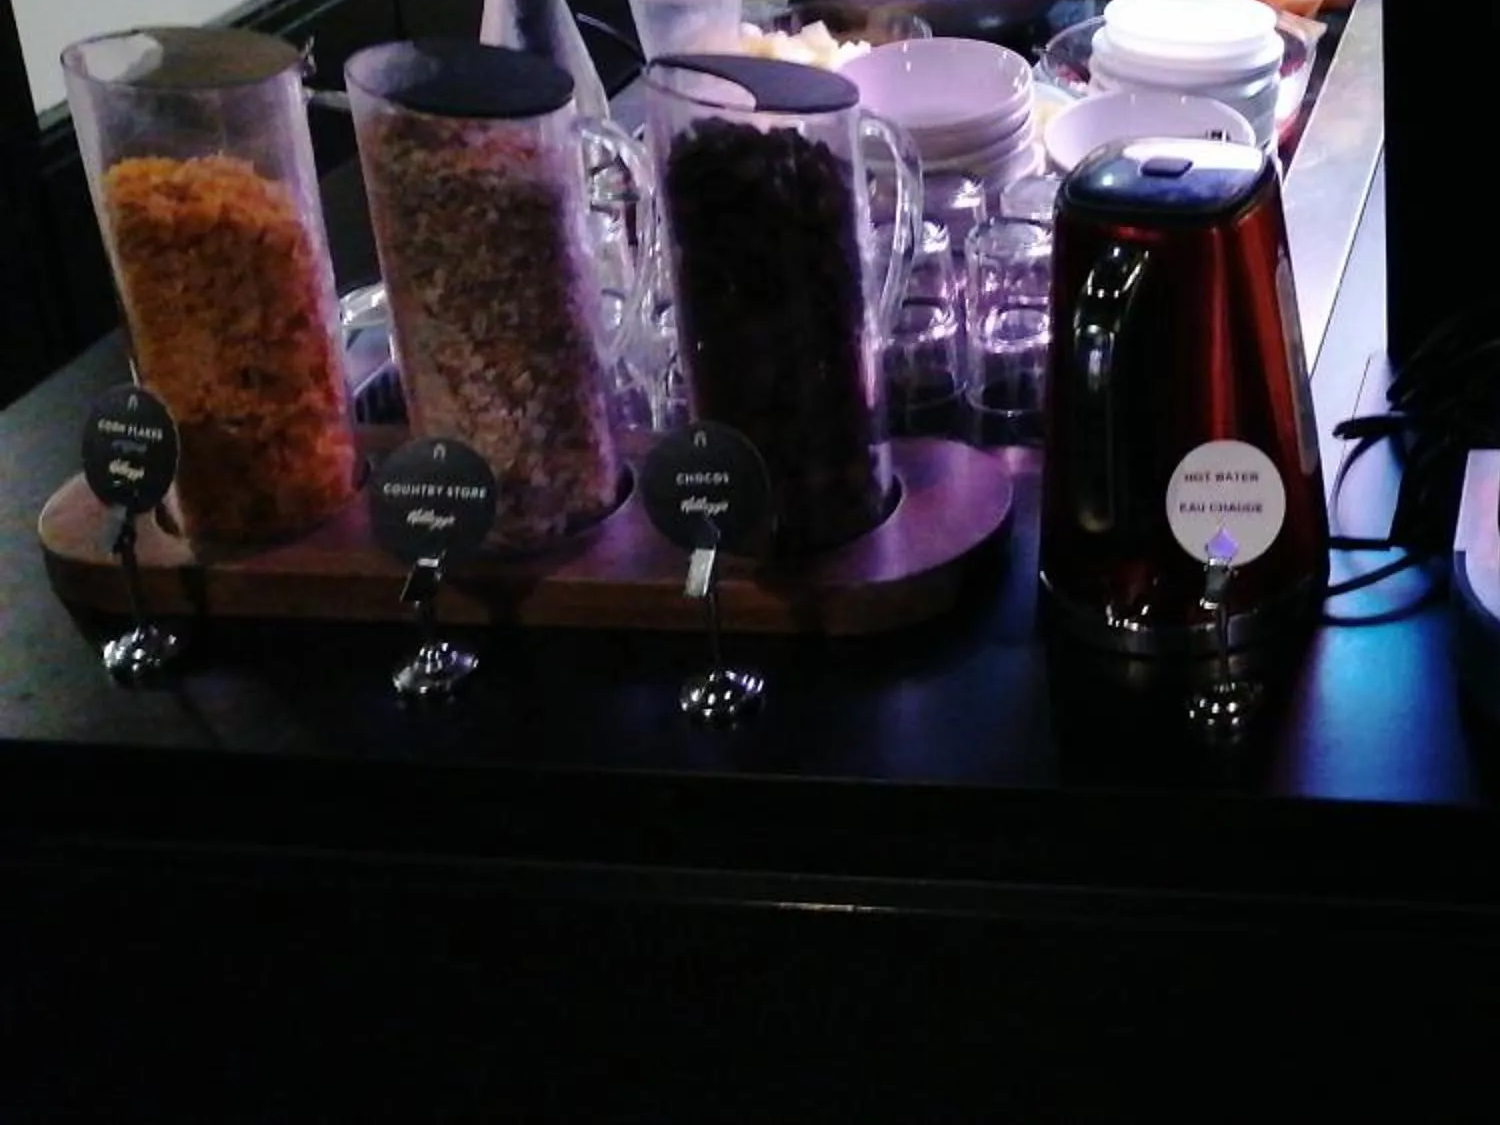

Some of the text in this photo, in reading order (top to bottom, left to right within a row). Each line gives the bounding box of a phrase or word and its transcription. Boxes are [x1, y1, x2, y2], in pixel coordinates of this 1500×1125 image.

[128, 425, 163, 442] FLAKES
[676, 472, 729, 485] CHOCOS
[1185, 473, 1259, 483] HOT WATER
[383, 482, 487, 499] COUNTRY STORE
[1180, 502, 1263, 513] EAU CHAUDE
